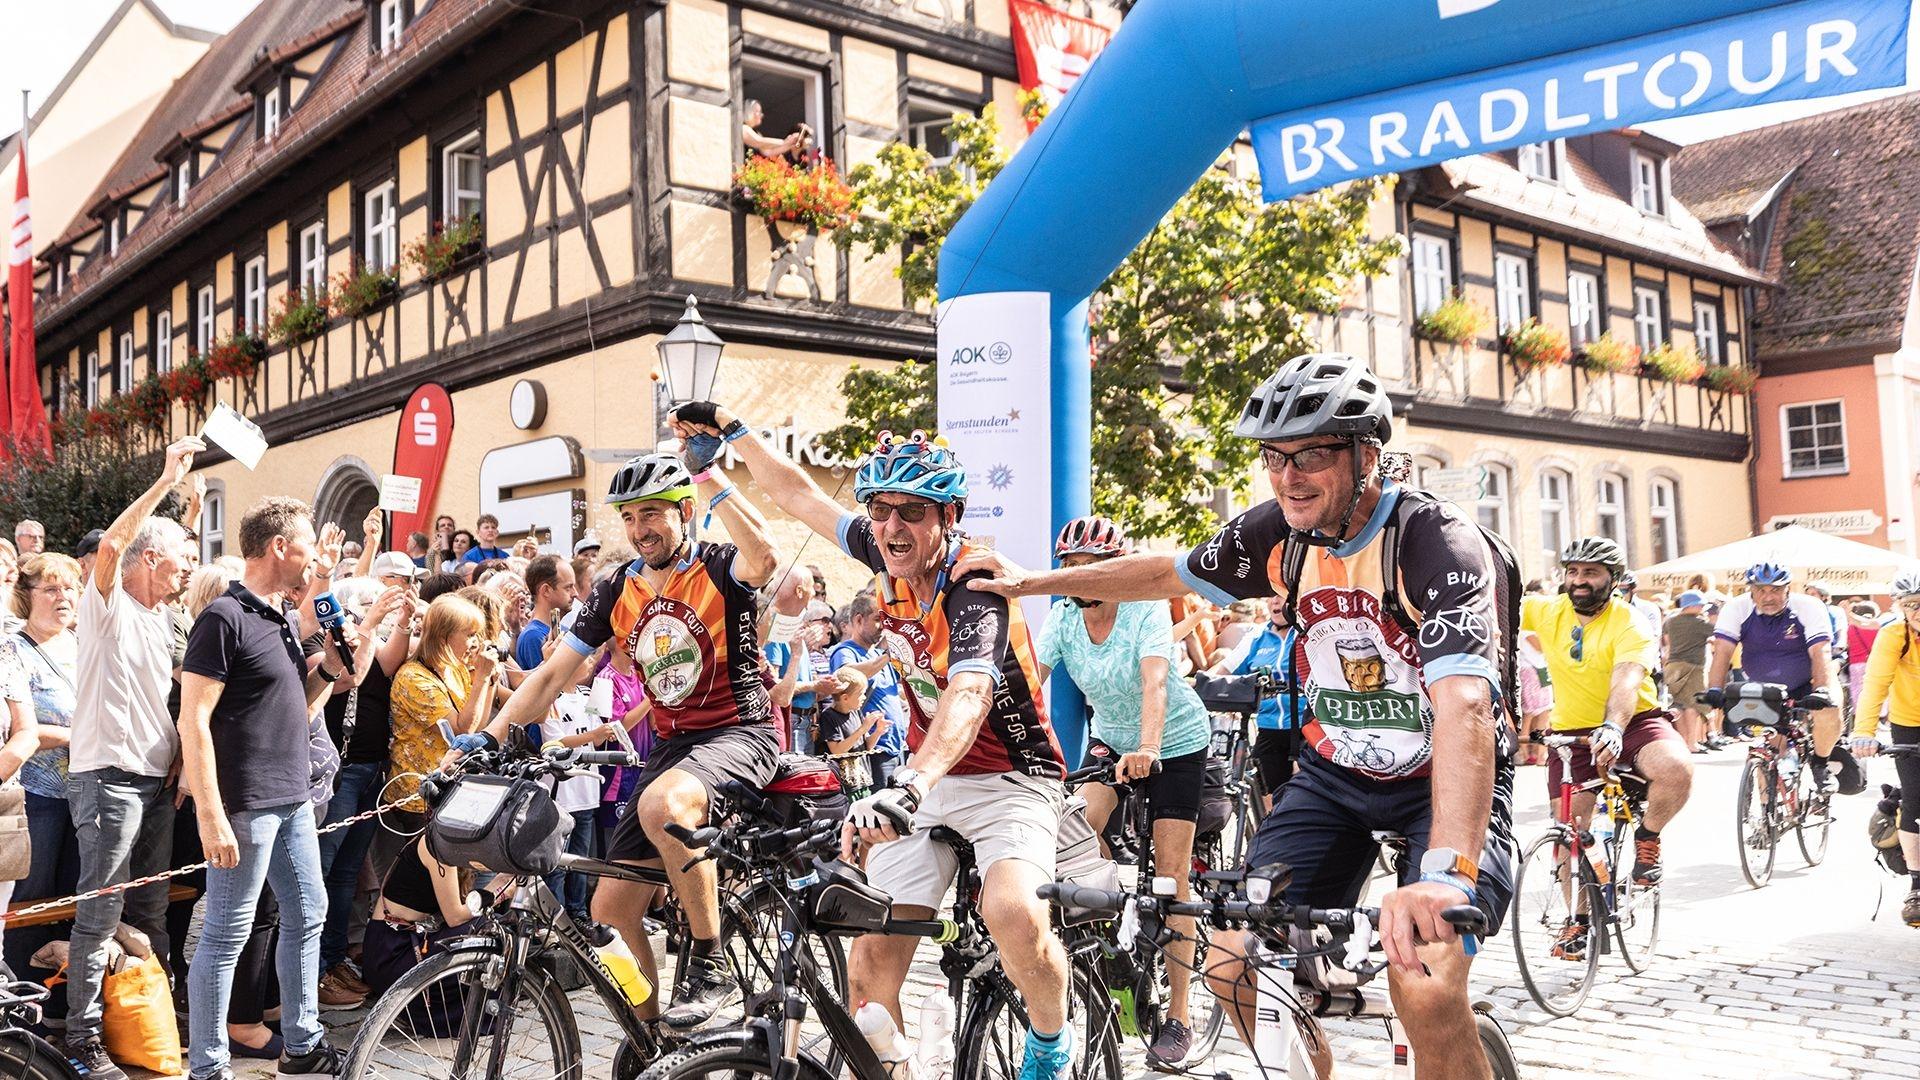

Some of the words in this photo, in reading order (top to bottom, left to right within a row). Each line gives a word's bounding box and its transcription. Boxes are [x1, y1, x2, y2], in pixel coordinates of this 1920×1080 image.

[1281, 119, 1358, 184] BR
[1369, 19, 1859, 165] RADLTOUR
[950, 346, 986, 366] AOK
[945, 416, 1009, 431] Sternstunden
[1234, 556, 1251, 579] TOUR
[1807, 567, 1869, 581] Hofmann
[647, 601, 675, 616] BIKE
[683, 609, 705, 636] TOUR
[739, 611, 752, 653] BIKE
[898, 623, 927, 645] BIKE
[652, 653, 684, 673] BEER!
[1323, 697, 1414, 721] BEER!
[1003, 713, 1027, 743] FOR
